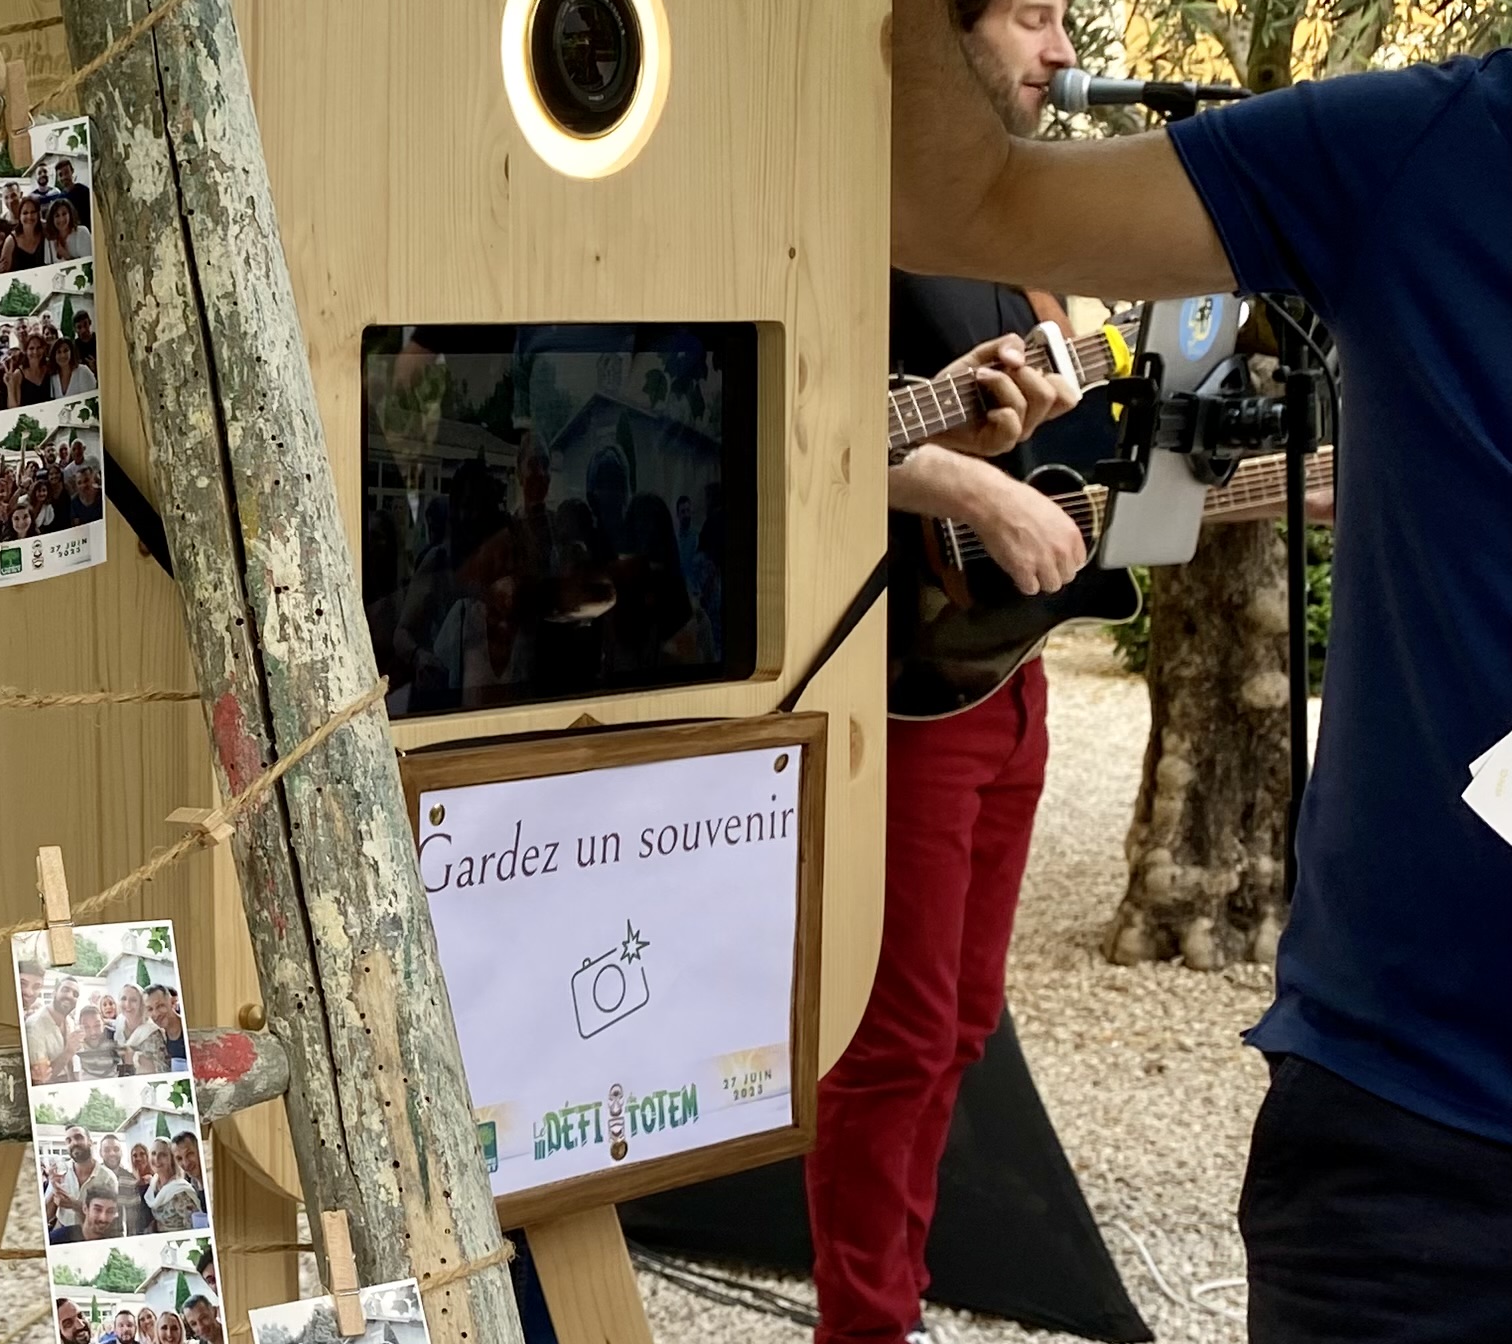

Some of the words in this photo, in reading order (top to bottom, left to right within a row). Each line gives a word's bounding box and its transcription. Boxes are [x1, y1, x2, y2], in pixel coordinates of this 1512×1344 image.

[65, 538, 88, 550] JUIN
[419, 819, 560, 893] Gardez
[576, 831, 620, 868] un
[638, 794, 794, 859] souvenir
[723, 1076, 737, 1089] 27
[744, 1069, 772, 1085] JUIN
[733, 1084, 763, 1101] 2023
[544, 1100, 604, 1156] DÉFI
[625, 1083, 699, 1137] TOTEM
